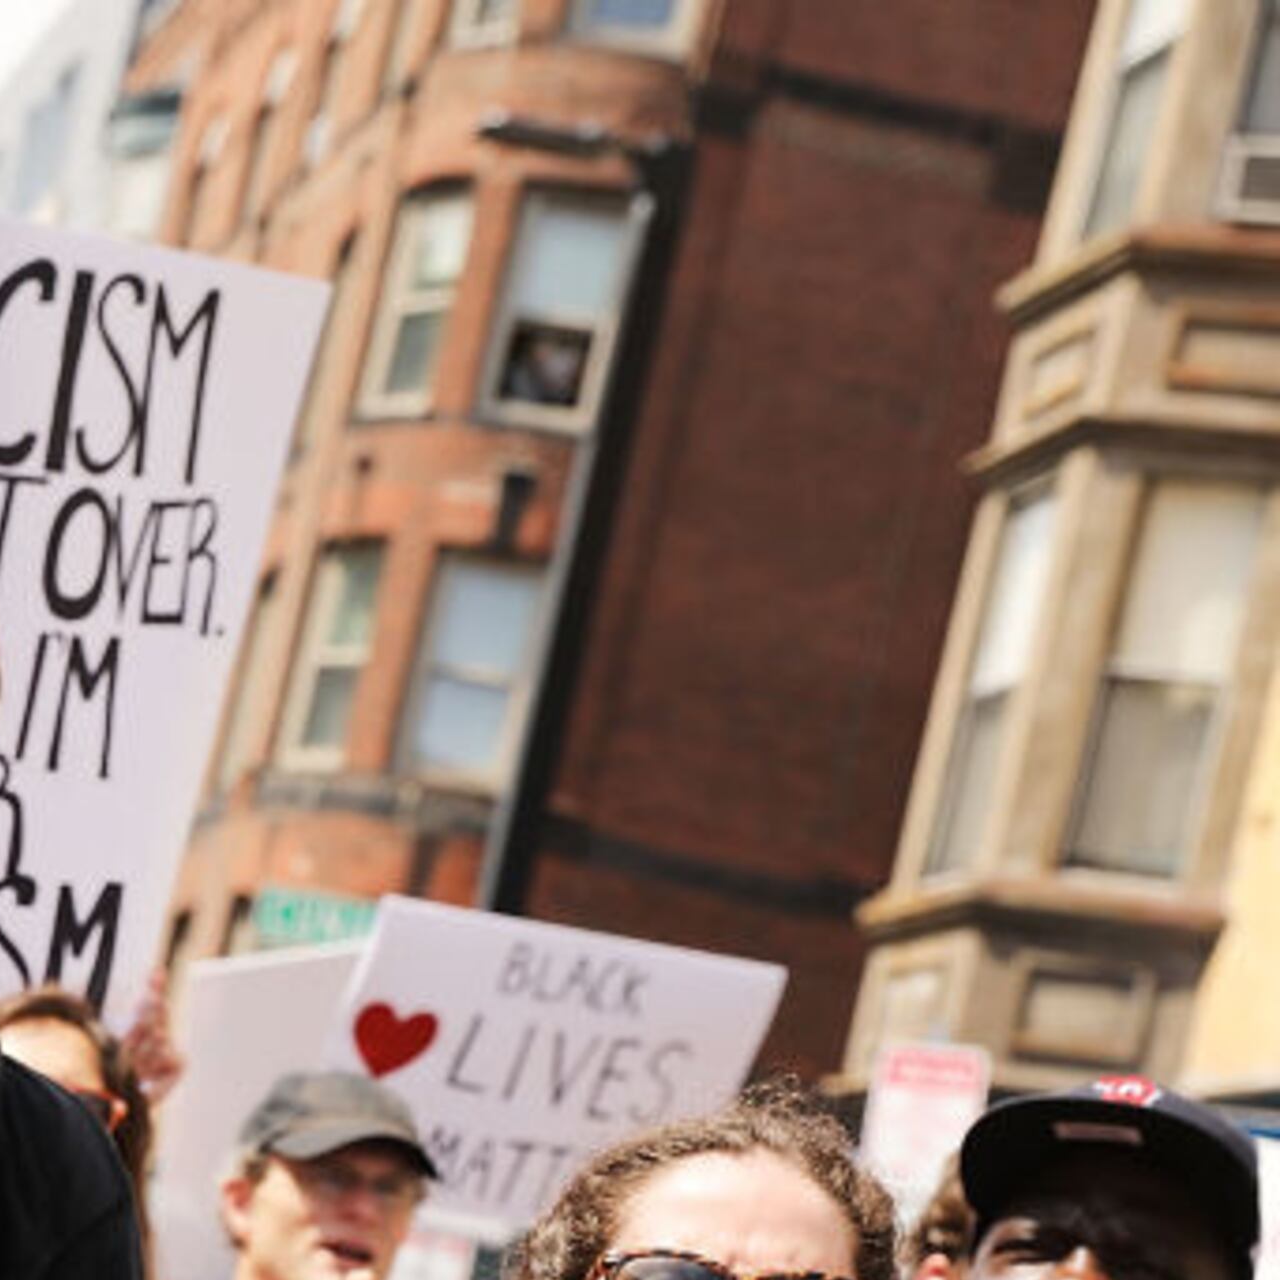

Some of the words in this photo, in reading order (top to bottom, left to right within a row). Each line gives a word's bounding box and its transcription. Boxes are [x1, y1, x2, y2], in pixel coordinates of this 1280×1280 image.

[44, 488, 226, 637] OVER.
[17, 633, 123, 781] I'M
[498, 942, 652, 1017] BLACK
[445, 1010, 694, 1124] LIVES
